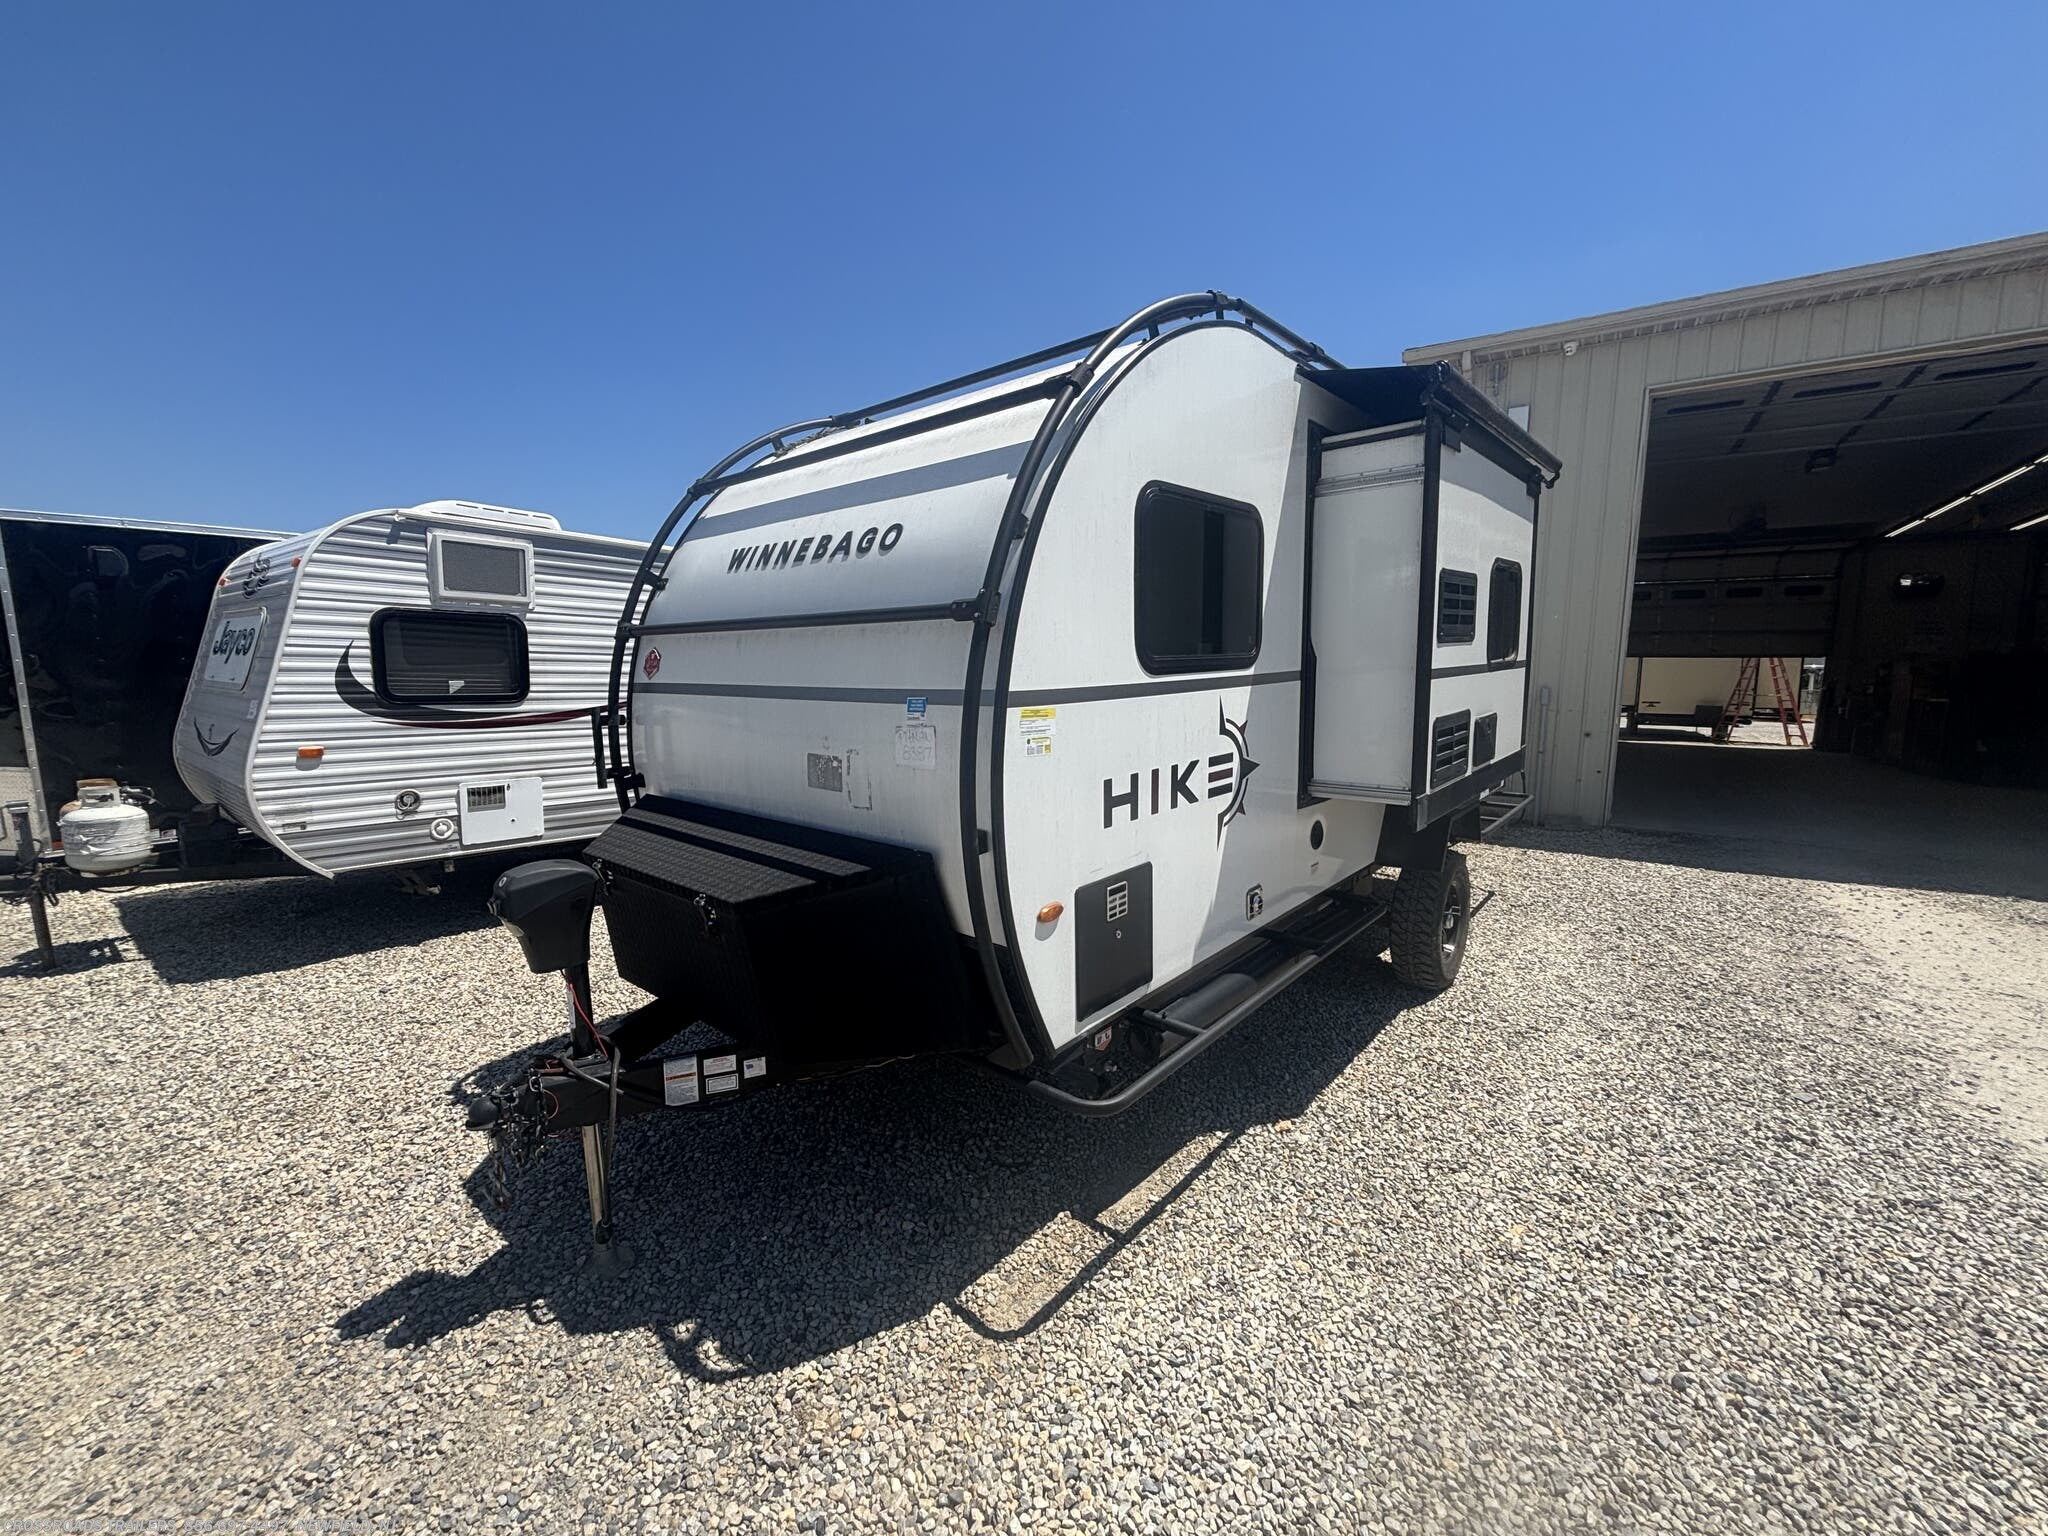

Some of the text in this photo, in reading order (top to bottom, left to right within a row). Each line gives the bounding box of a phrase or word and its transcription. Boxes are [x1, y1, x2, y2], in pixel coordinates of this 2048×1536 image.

[727, 523, 903, 574] WINNEBAGO
[212, 620, 256, 664] Jayco
[1103, 752, 1234, 829] HIKE
